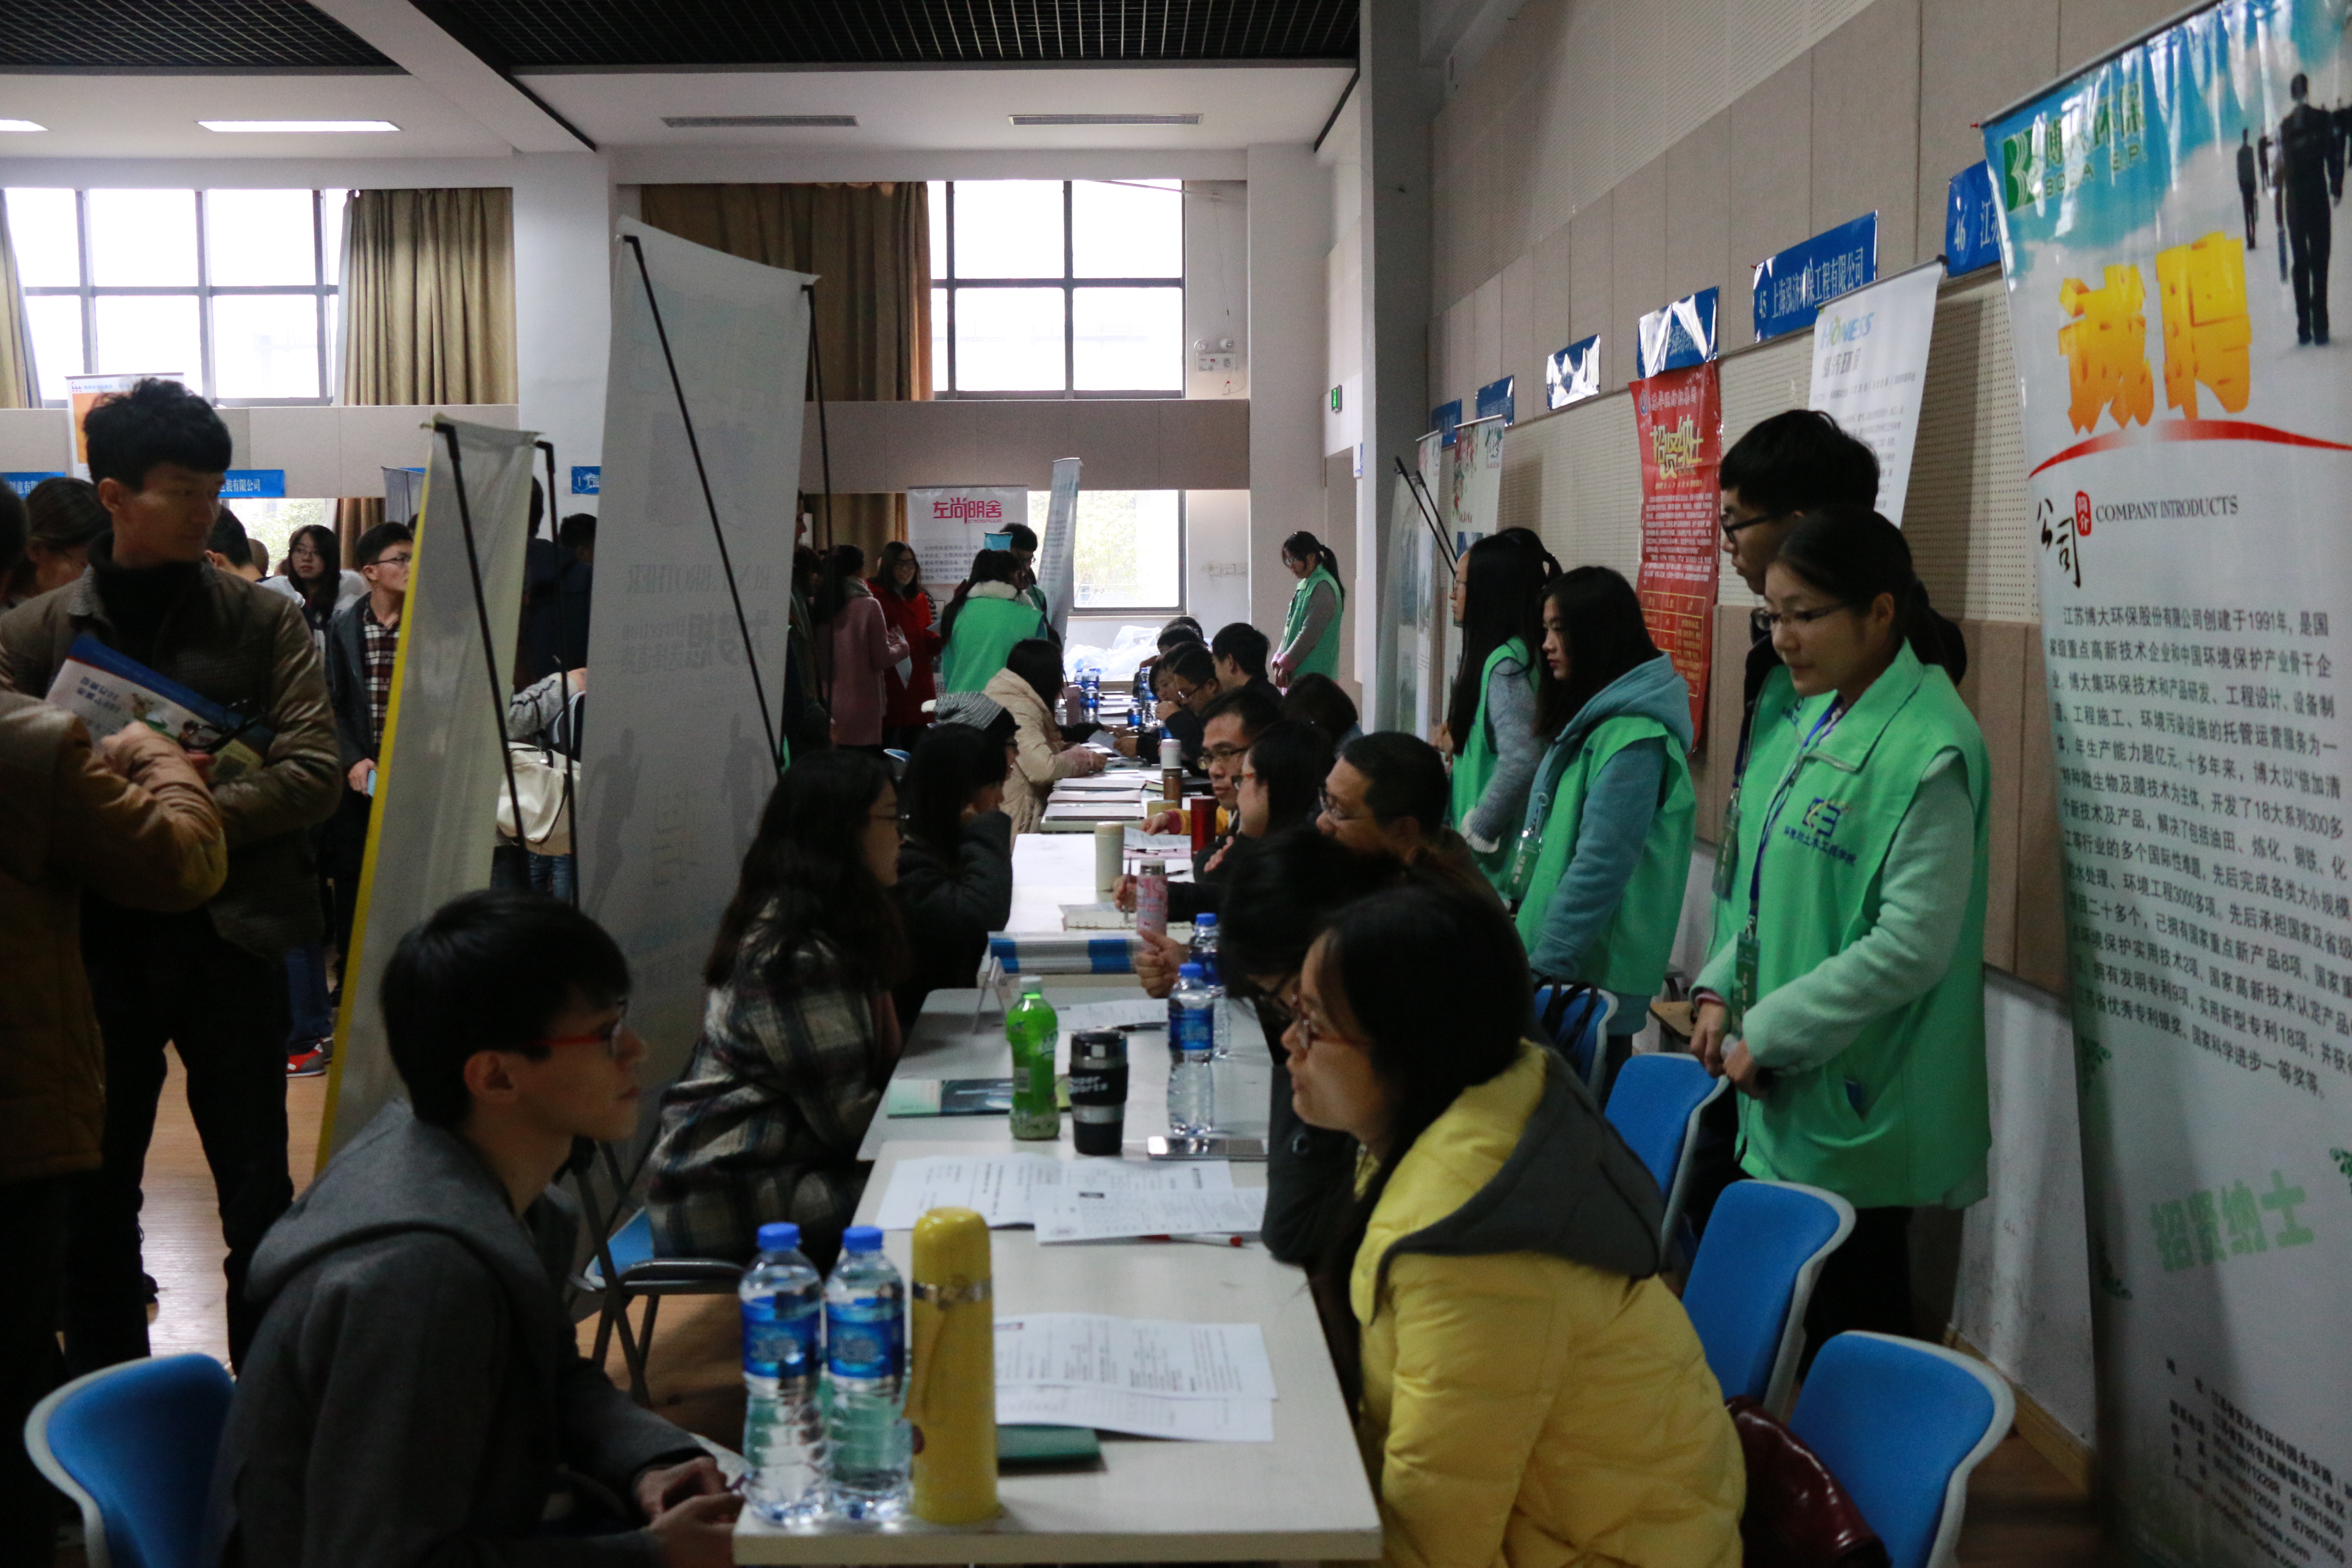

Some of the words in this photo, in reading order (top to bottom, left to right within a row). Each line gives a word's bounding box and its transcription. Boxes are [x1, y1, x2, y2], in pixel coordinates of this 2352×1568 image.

[1954, 220, 1966, 251] 46
[1758, 292, 1767, 318] 45
[1819, 312, 1874, 350] HONESS
[933, 497, 1002, 524] 左尚明舍
[2095, 502, 2159, 521] COMPANY
[2160, 494, 2239, 519] INTRODUCTS
